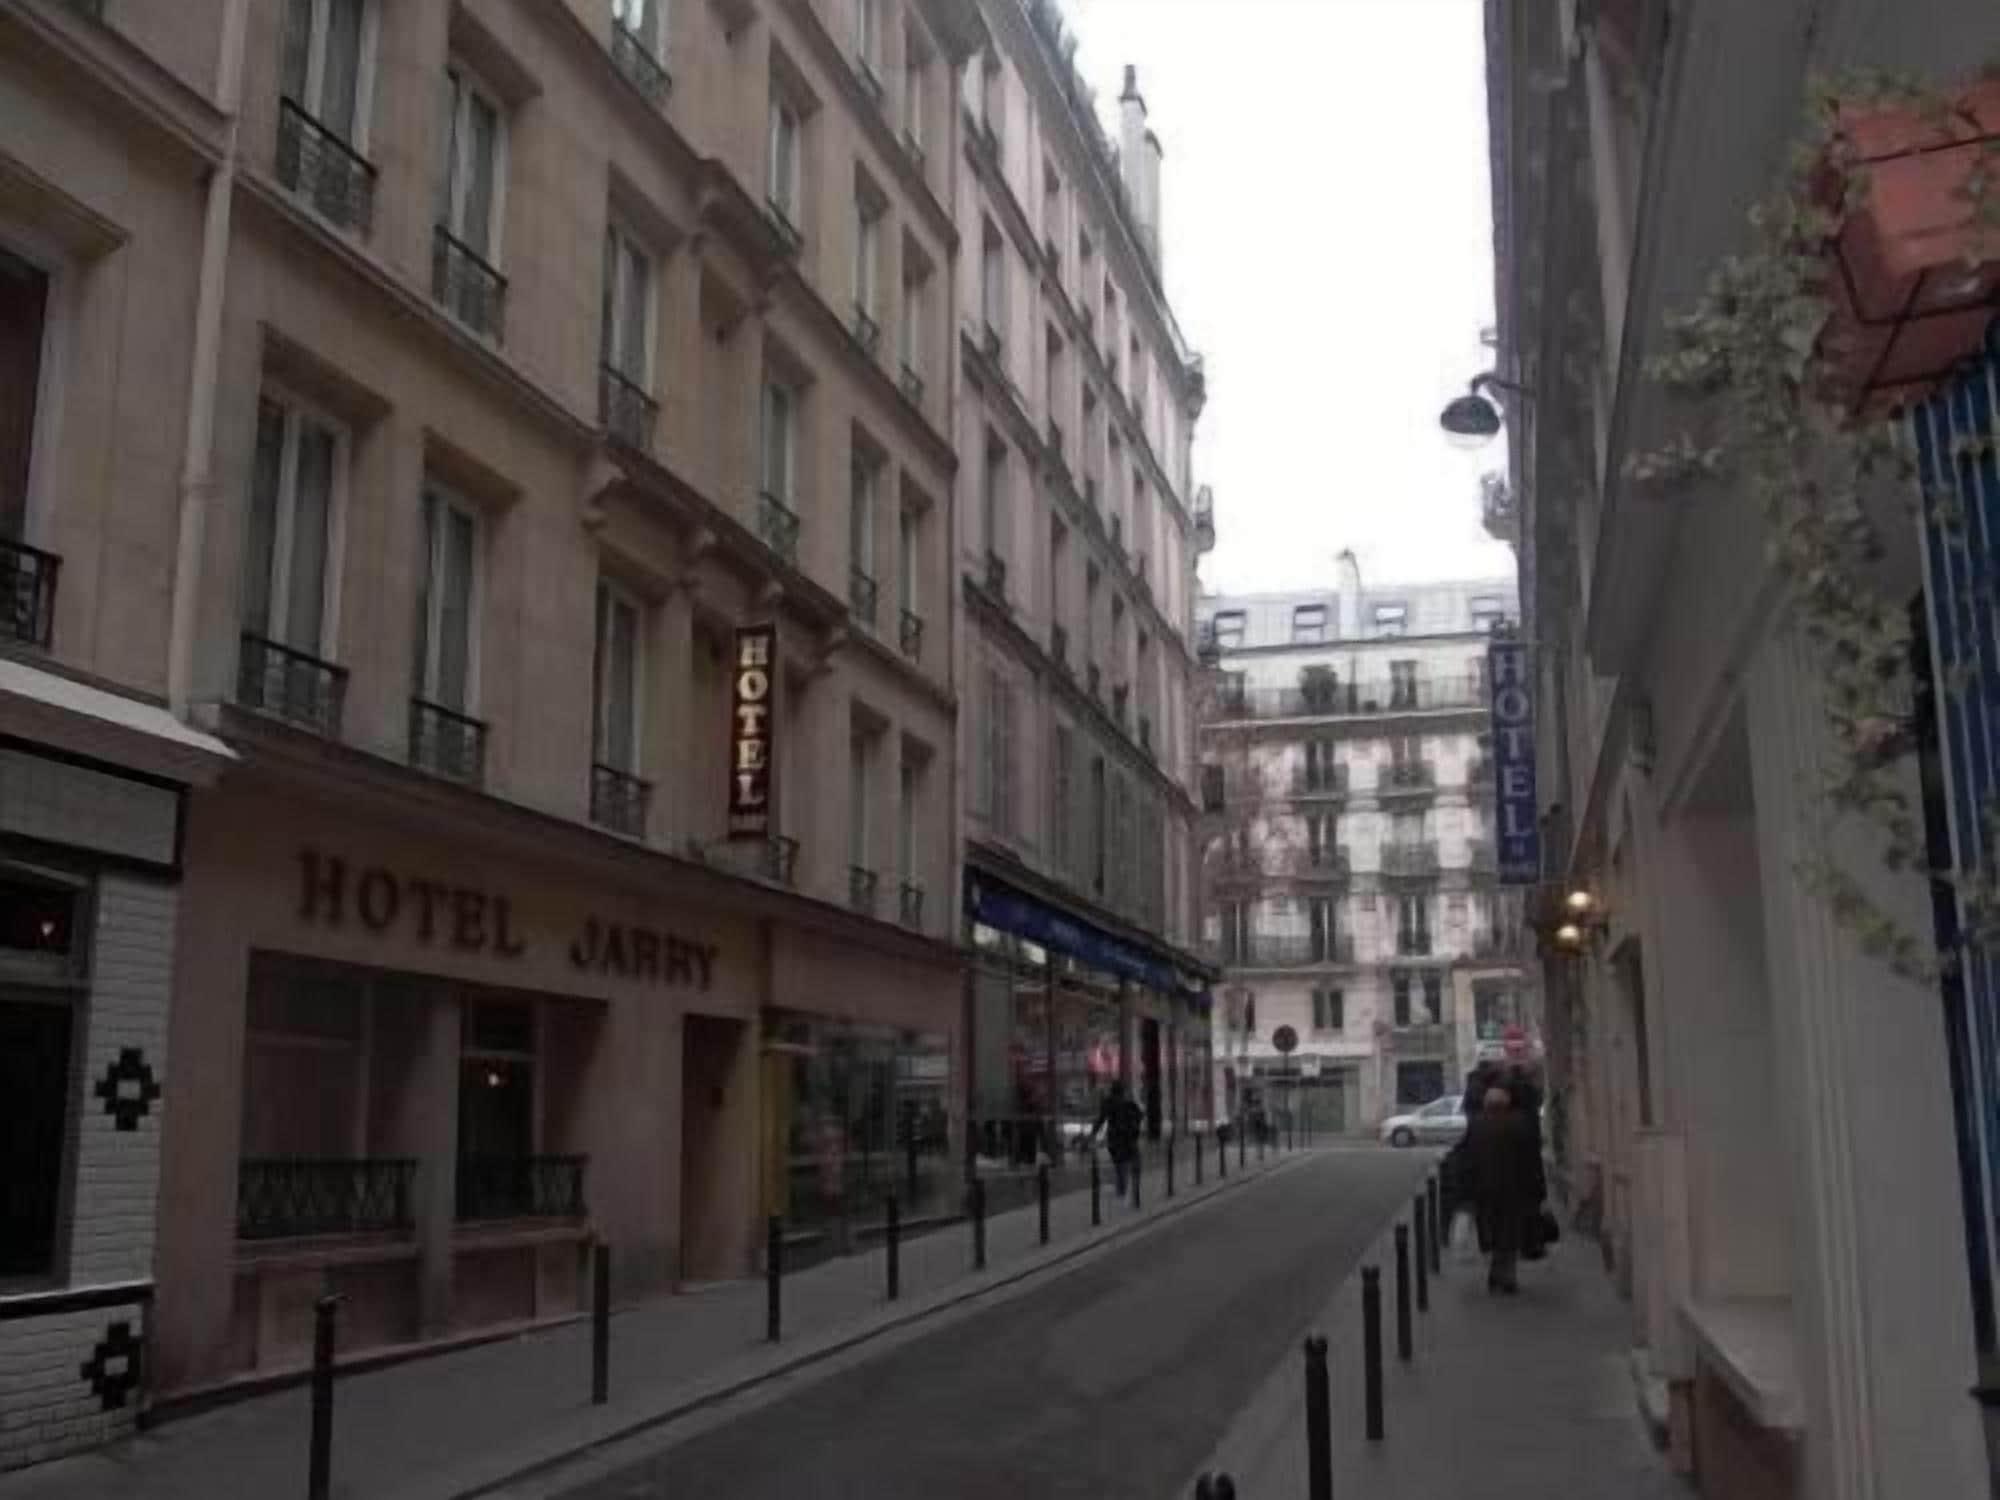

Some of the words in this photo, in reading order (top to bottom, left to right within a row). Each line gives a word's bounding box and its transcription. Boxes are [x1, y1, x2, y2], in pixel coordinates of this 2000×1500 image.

[736, 633, 769, 806] HOTEL
[1495, 650, 1532, 838] HOTEL
[297, 849, 526, 959] HOTEL
[568, 914, 719, 991] JARRY
